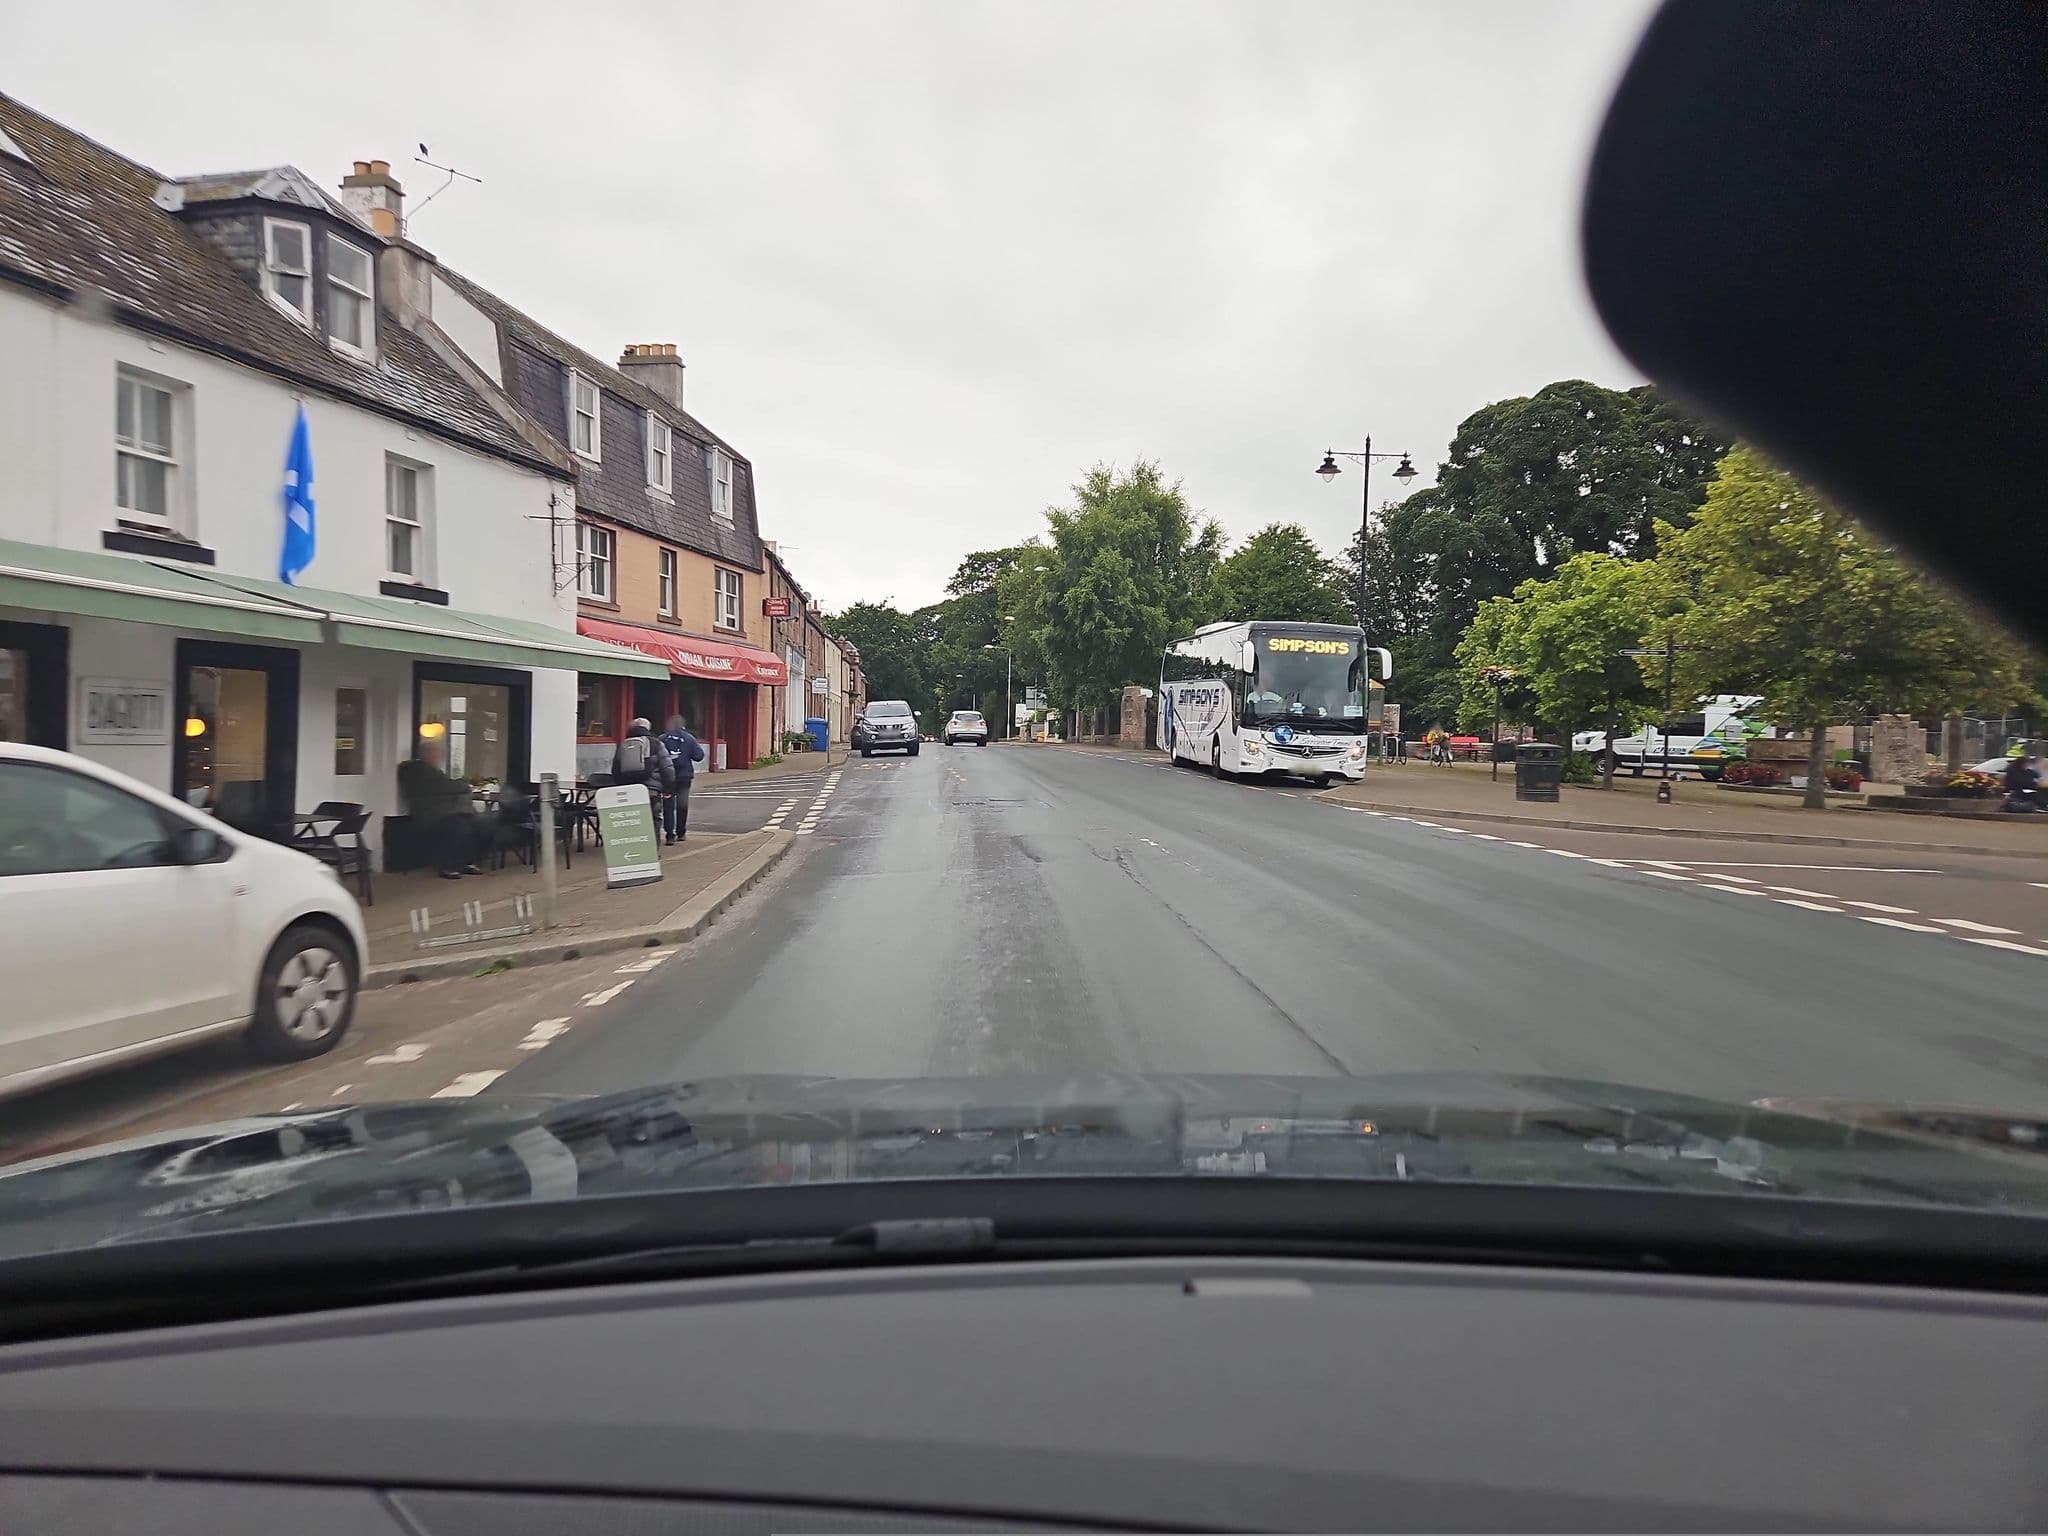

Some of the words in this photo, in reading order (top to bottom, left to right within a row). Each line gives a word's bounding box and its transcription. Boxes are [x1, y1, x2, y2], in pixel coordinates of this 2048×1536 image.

[1268, 638, 1350, 655] SIMPSON'S
[678, 651, 704, 667] INDIAN
[705, 656, 733, 671] CUISINE
[1178, 688, 1220, 707] SIMPSON'S
[610, 835, 648, 847] ENTRANCE
